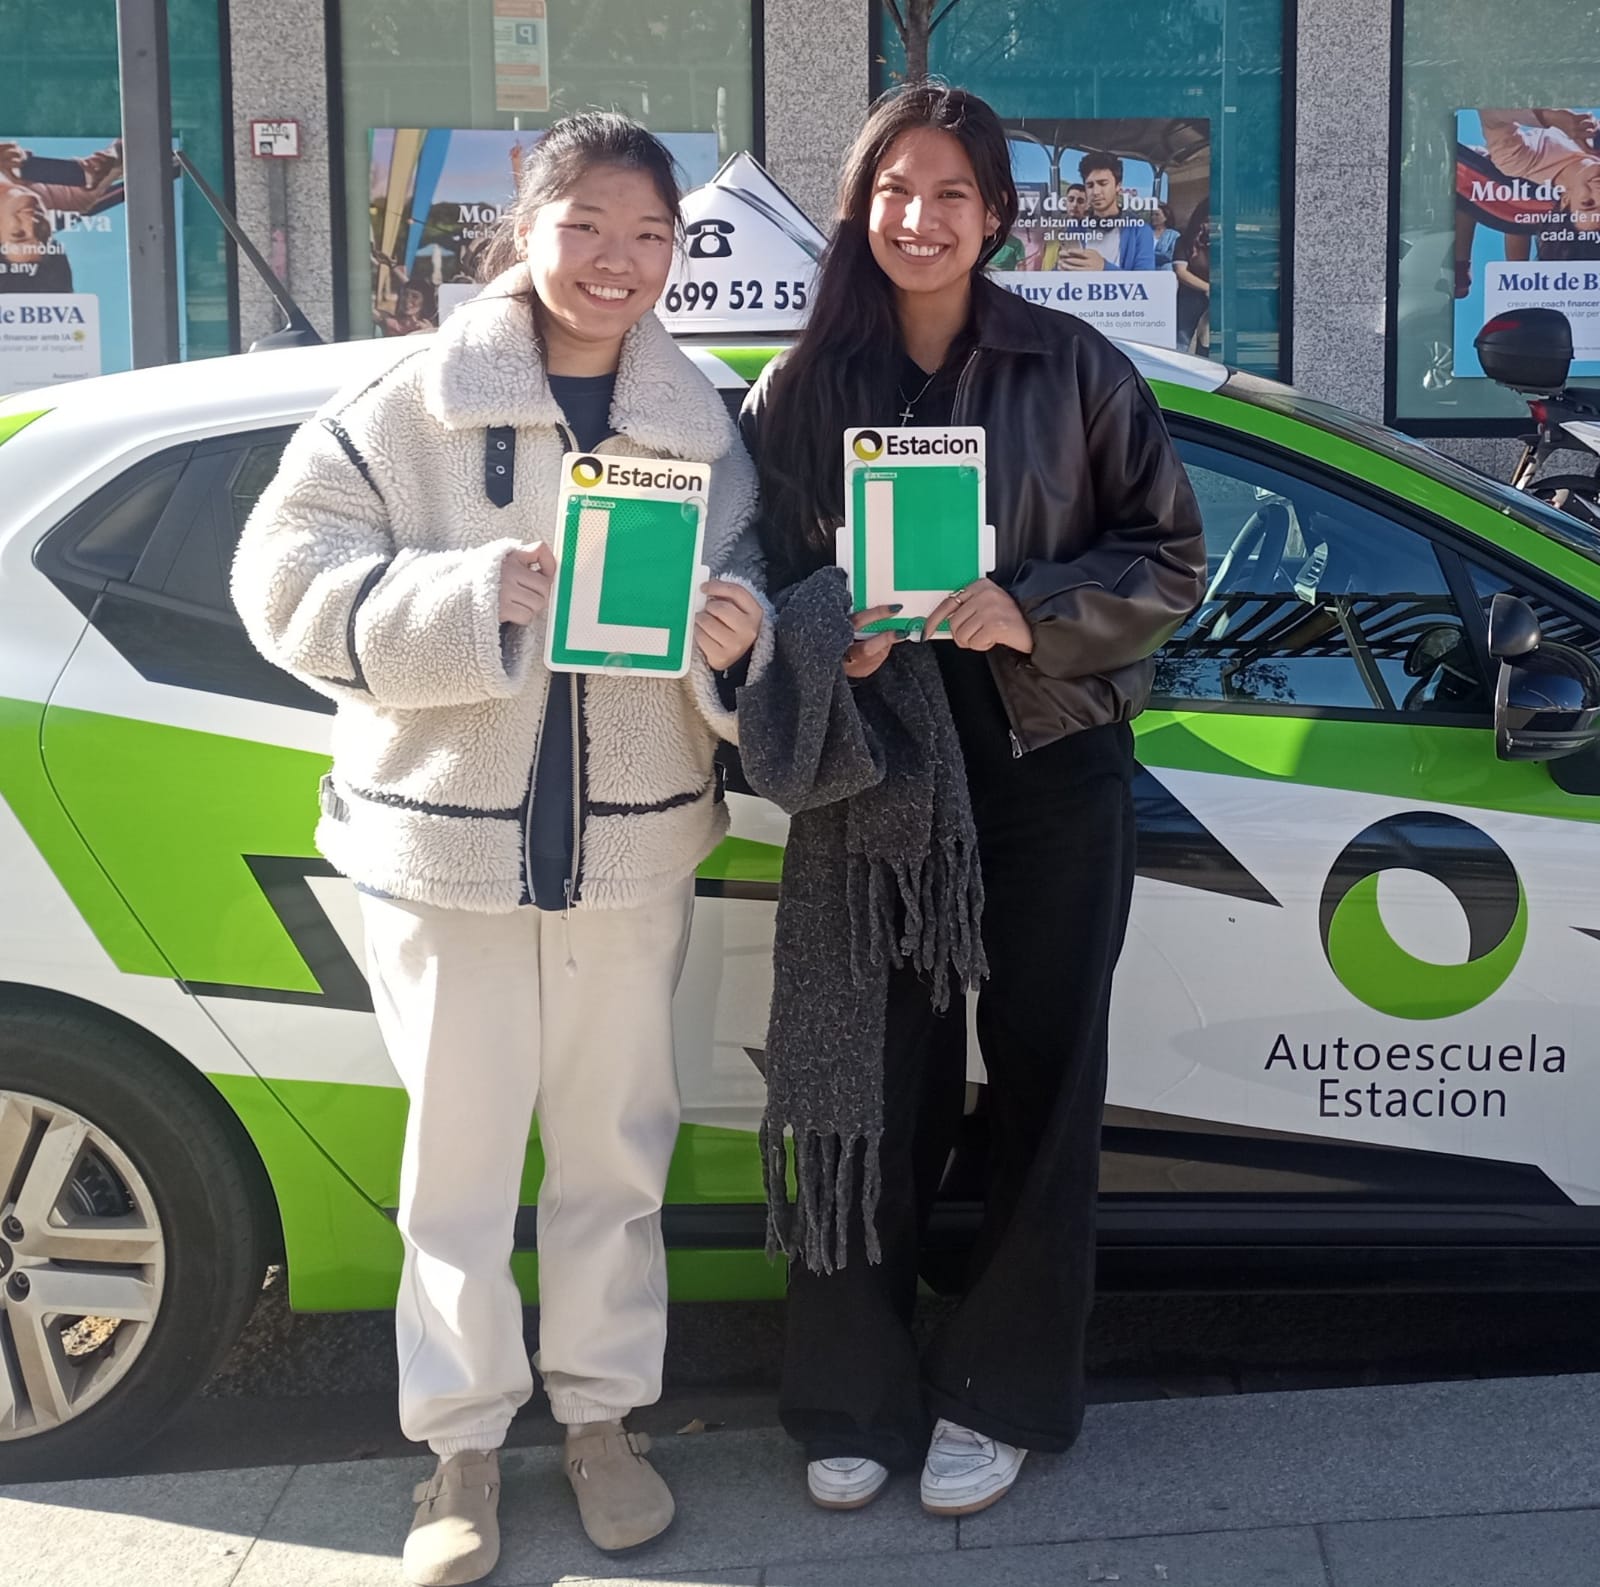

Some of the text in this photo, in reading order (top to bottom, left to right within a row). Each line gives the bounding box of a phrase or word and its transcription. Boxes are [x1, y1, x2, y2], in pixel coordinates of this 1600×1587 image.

[1470, 178, 1566, 202] Molt de
[457, 204, 504, 223] Mol
[1015, 216, 1145, 228] cer bizum de camino
[1515, 210, 1566, 223] canviar
[1570, 210, 1587, 222] de
[1043, 231, 1104, 242] al cumple
[1541, 228, 1600, 243] cada any
[10, 263, 38, 277] any
[1498, 272, 1550, 291] Molt
[1553, 272, 1579, 291] de
[665, 280, 806, 312] 699 52 55
[1005, 282, 1149, 305] Muy de BBVA
[1541, 300, 1565, 308] coach
[0, 305, 86, 324] e BBVA
[1122, 310, 1145, 318] datos
[887, 434, 978, 455] Estacion
[606, 463, 702, 491] Estacion
[865, 481, 966, 619] L
[565, 508, 670, 656] L
[1264, 1033, 1566, 1073] Autoescuela
[1319, 1078, 1506, 1117] Estacion
